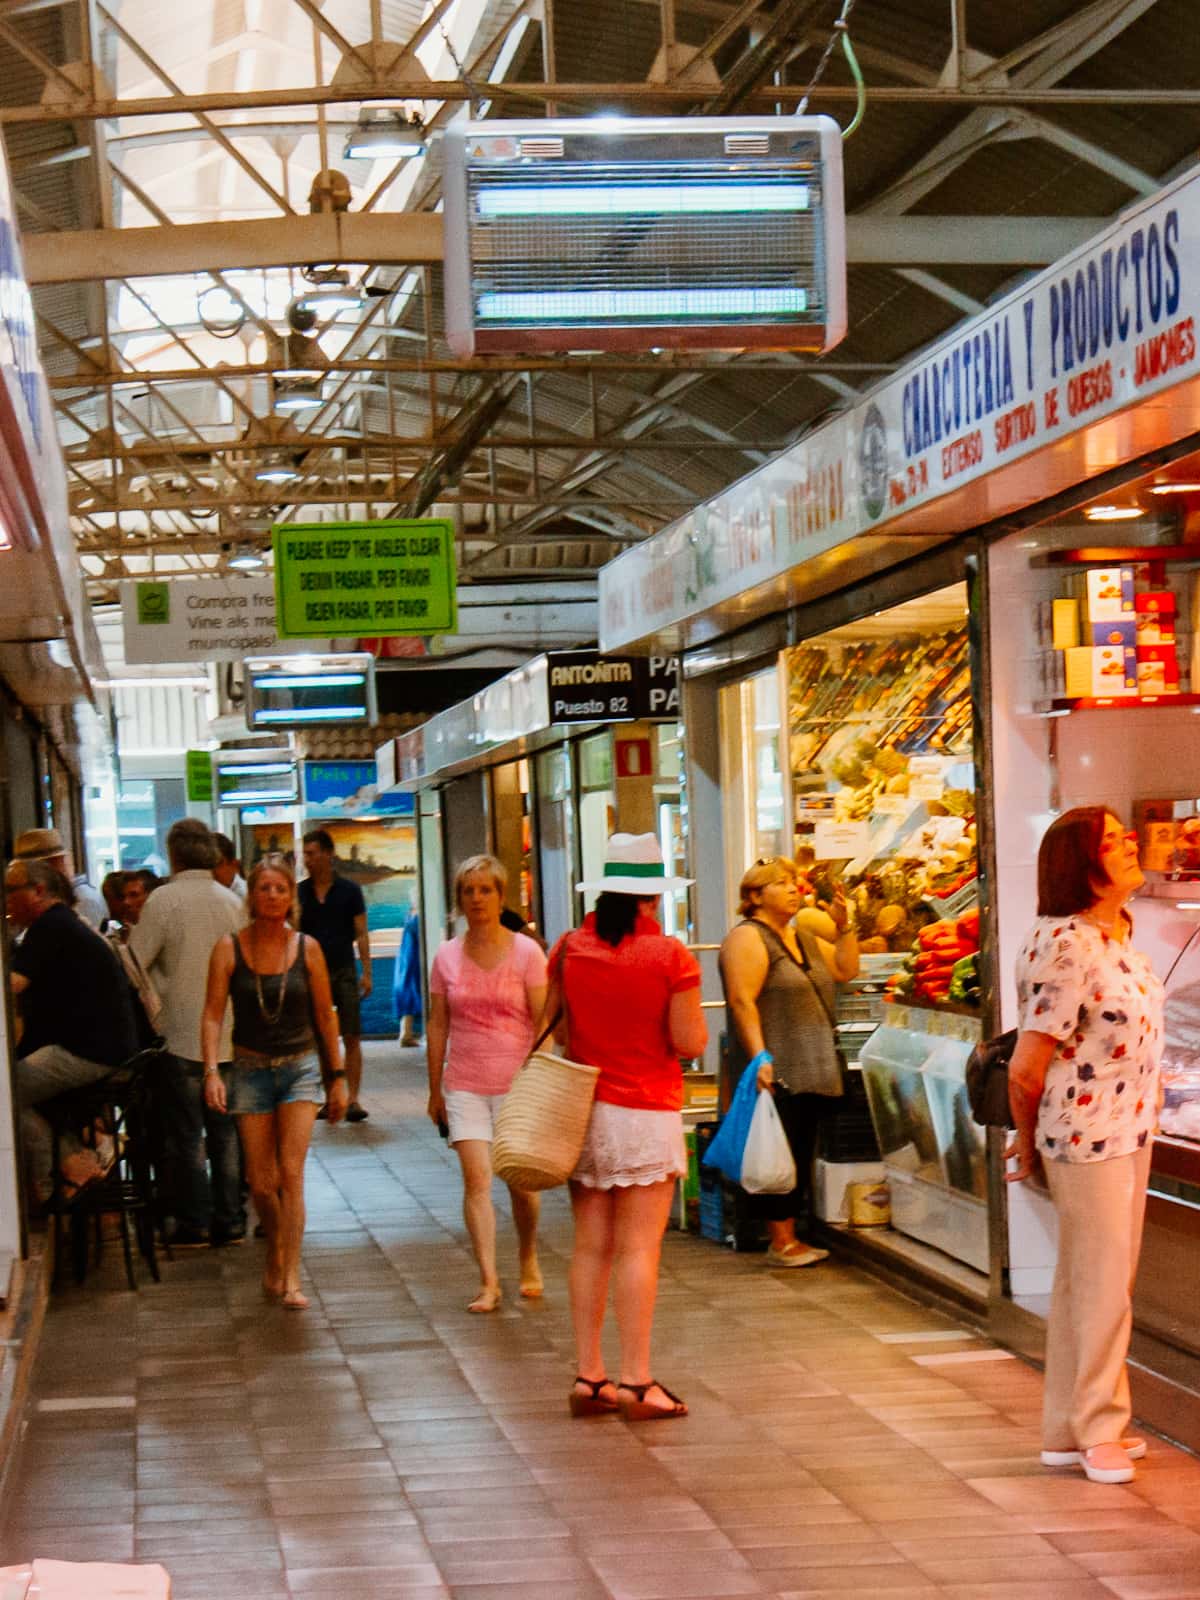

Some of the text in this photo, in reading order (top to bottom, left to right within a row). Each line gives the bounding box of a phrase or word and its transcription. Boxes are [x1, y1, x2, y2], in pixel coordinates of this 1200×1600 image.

[903, 316, 1014, 458] CHARCUTERIA
[1024, 299, 1034, 391] Y
[1050, 208, 1180, 377] PRODUCTOS
[942, 429, 983, 480] EXTENSO
[995, 401, 1036, 453] SURTIDO
[1044, 387, 1059, 429] DE
[1067, 360, 1113, 417] QUESOS
[1134, 316, 1196, 386] JAMONES
[287, 542, 323, 560] PLEASE
[326, 540, 351, 558] KEEP
[352, 540, 371, 558] THE
[374, 538, 406, 557] AISLES
[377, 569, 396, 587] PER
[399, 568, 431, 587] FAVOR
[186, 594, 247, 610] Compra
[398, 599, 428, 617] FAVOR
[187, 616, 221, 629] Vine
[226, 615, 249, 629] als
[551, 661, 632, 686] ANTOÑITA
[554, 697, 628, 716] Puesto 82
